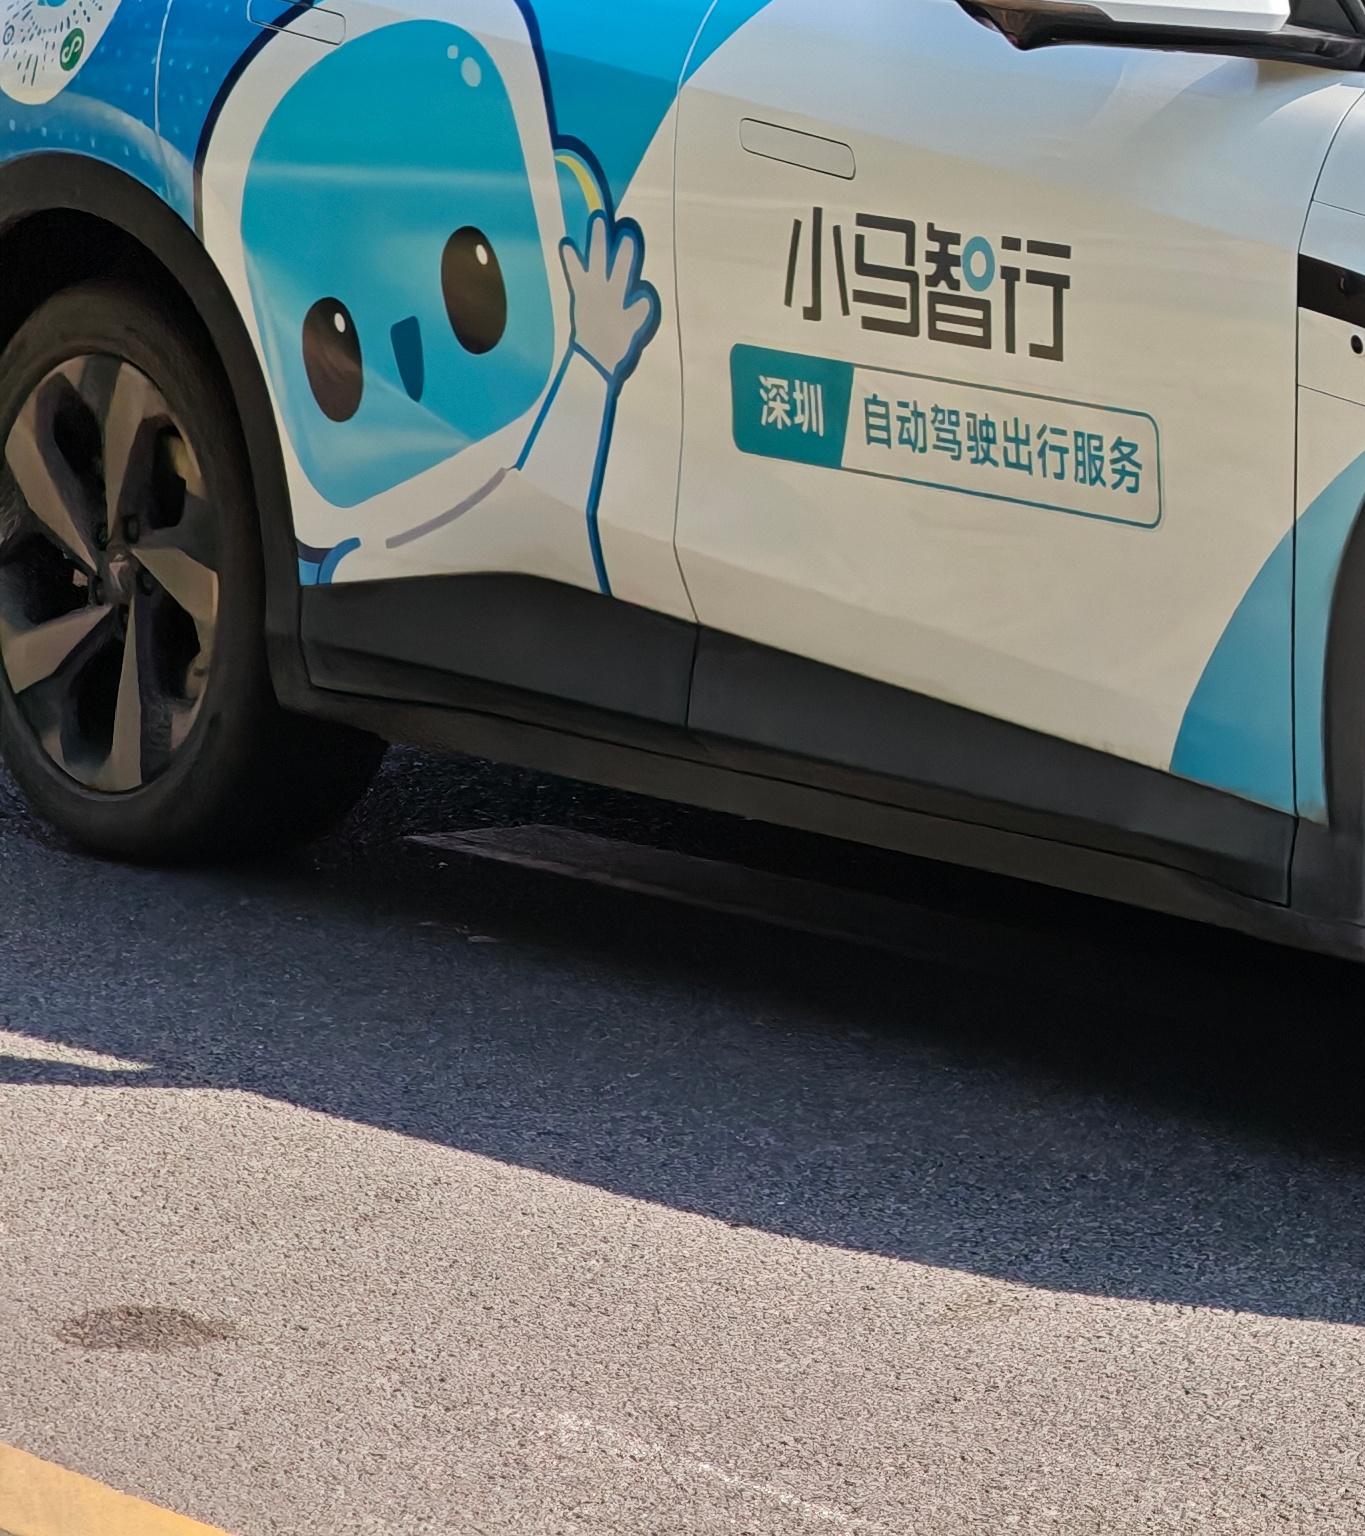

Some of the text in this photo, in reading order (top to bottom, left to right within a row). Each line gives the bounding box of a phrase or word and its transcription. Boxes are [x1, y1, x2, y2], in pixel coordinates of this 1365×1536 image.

[784, 206, 1072, 362] 小马智行
[758, 375, 1143, 495] 深圳 自动驾驶出行服务
